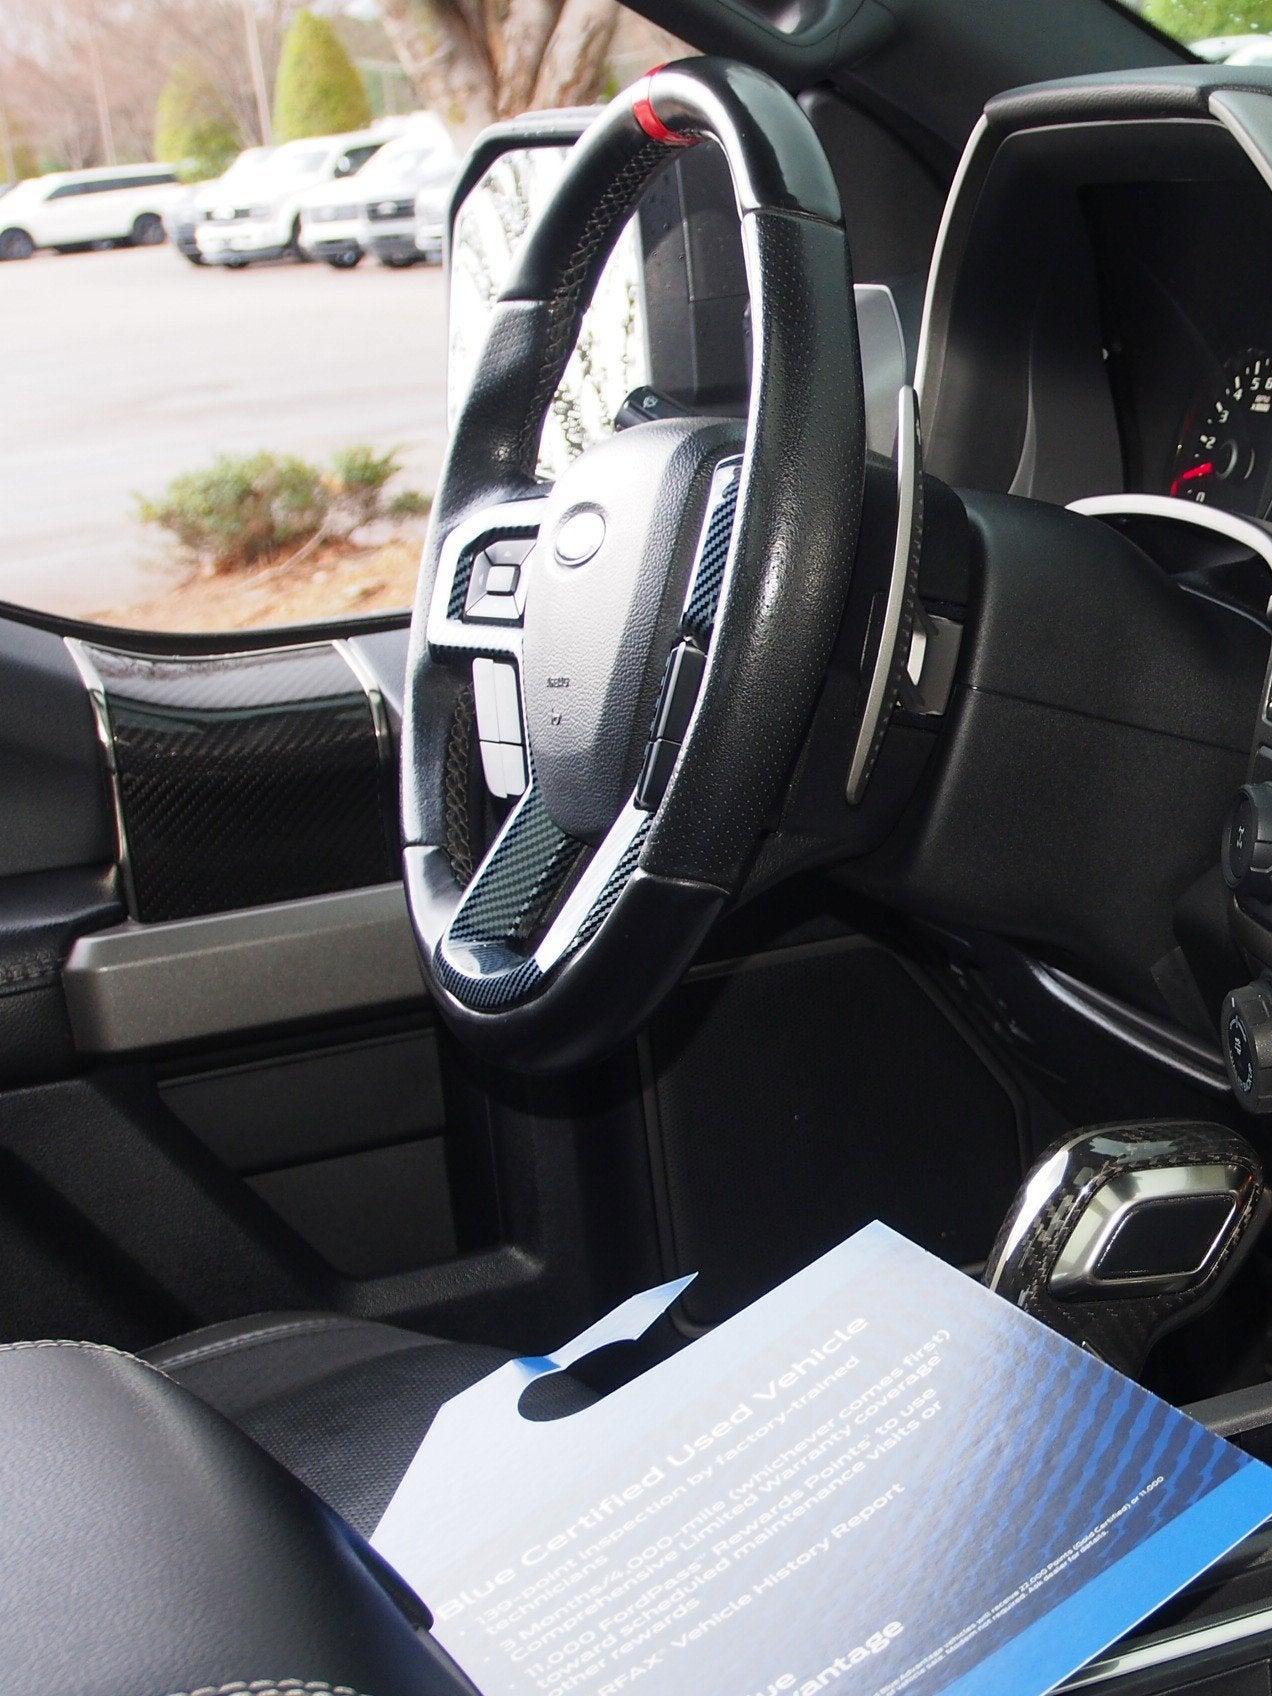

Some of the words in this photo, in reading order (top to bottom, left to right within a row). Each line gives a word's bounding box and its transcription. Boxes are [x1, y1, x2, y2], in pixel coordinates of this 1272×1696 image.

[1219, 410, 1229, 423] 3
[1233, 388, 1243, 401] 4
[1250, 377, 1261, 391] 5
[1206, 437, 1216, 450] 2
[437, 1568, 516, 1621] Blue
[521, 1466, 666, 1566] Certified
[666, 1403, 754, 1467] Used
[752, 1317, 870, 1401] Vehicle
[500, 1638, 517, 1653] 3
[728, 1418, 836, 1500] (whichever
[838, 1367, 904, 1420] comes
[903, 1329, 951, 1367] first)
[579, 1485, 687, 1561] inspection
[687, 1465, 713, 1486] by
[715, 1355, 860, 1466] factory-trained
[712, 1489, 804, 1556] Rewards
[874, 1418, 899, 1436] to
[900, 1387, 937, 1418] use
[511, 1551, 679, 1662] Comprehensive
[679, 1493, 759, 1551] Limited
[758, 1424, 852, 1493] Warranty
[854, 1355, 942, 1426] coverage
[537, 1634, 618, 1690] toward
[620, 1557, 730, 1637] scheduled
[733, 1460, 867, 1560] maintenance
[866, 1420, 920, 1460] visits
[921, 1401, 943, 1420] or
[1047, 1549, 1074, 1571] Points
[1094, 1503, 1131, 1534] Certified)
[486, 1555, 609, 1636] technicians
[670, 1594, 753, 1648] Vehicle
[752, 1537, 830, 1595] History
[831, 1482, 905, 1539] Report
[549, 1658, 606, 1696] other
[611, 1597, 700, 1661] rewards
[792, 1620, 904, 1696] antage
